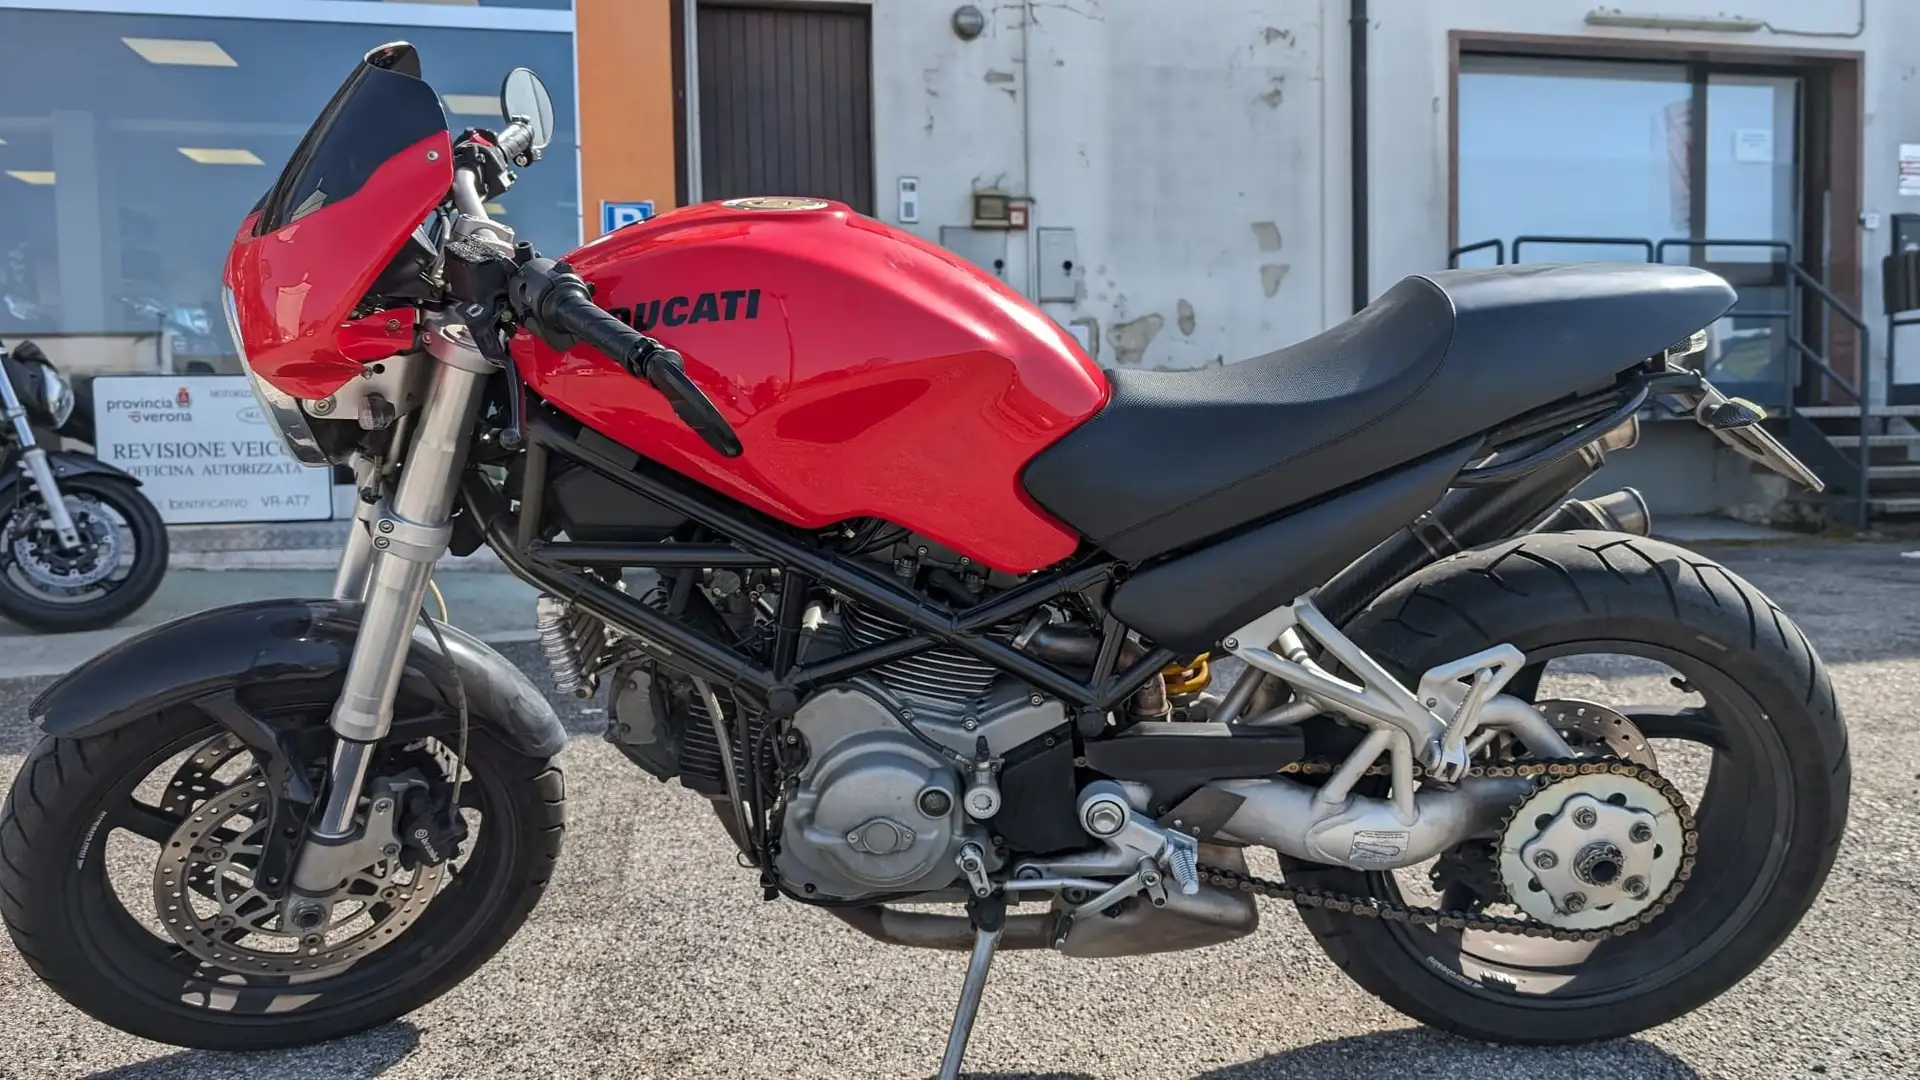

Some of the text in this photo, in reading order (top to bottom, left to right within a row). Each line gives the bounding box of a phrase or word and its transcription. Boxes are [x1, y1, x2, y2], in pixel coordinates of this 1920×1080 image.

[614, 207, 644, 230] P
[106, 396, 173, 413] provincia
[143, 411, 192, 422] verona
[113, 442, 226, 459] REVISIONE
[127, 462, 303, 477] OFFICINA AUTORIZZATA
[260, 494, 310, 508] VR-AT7
